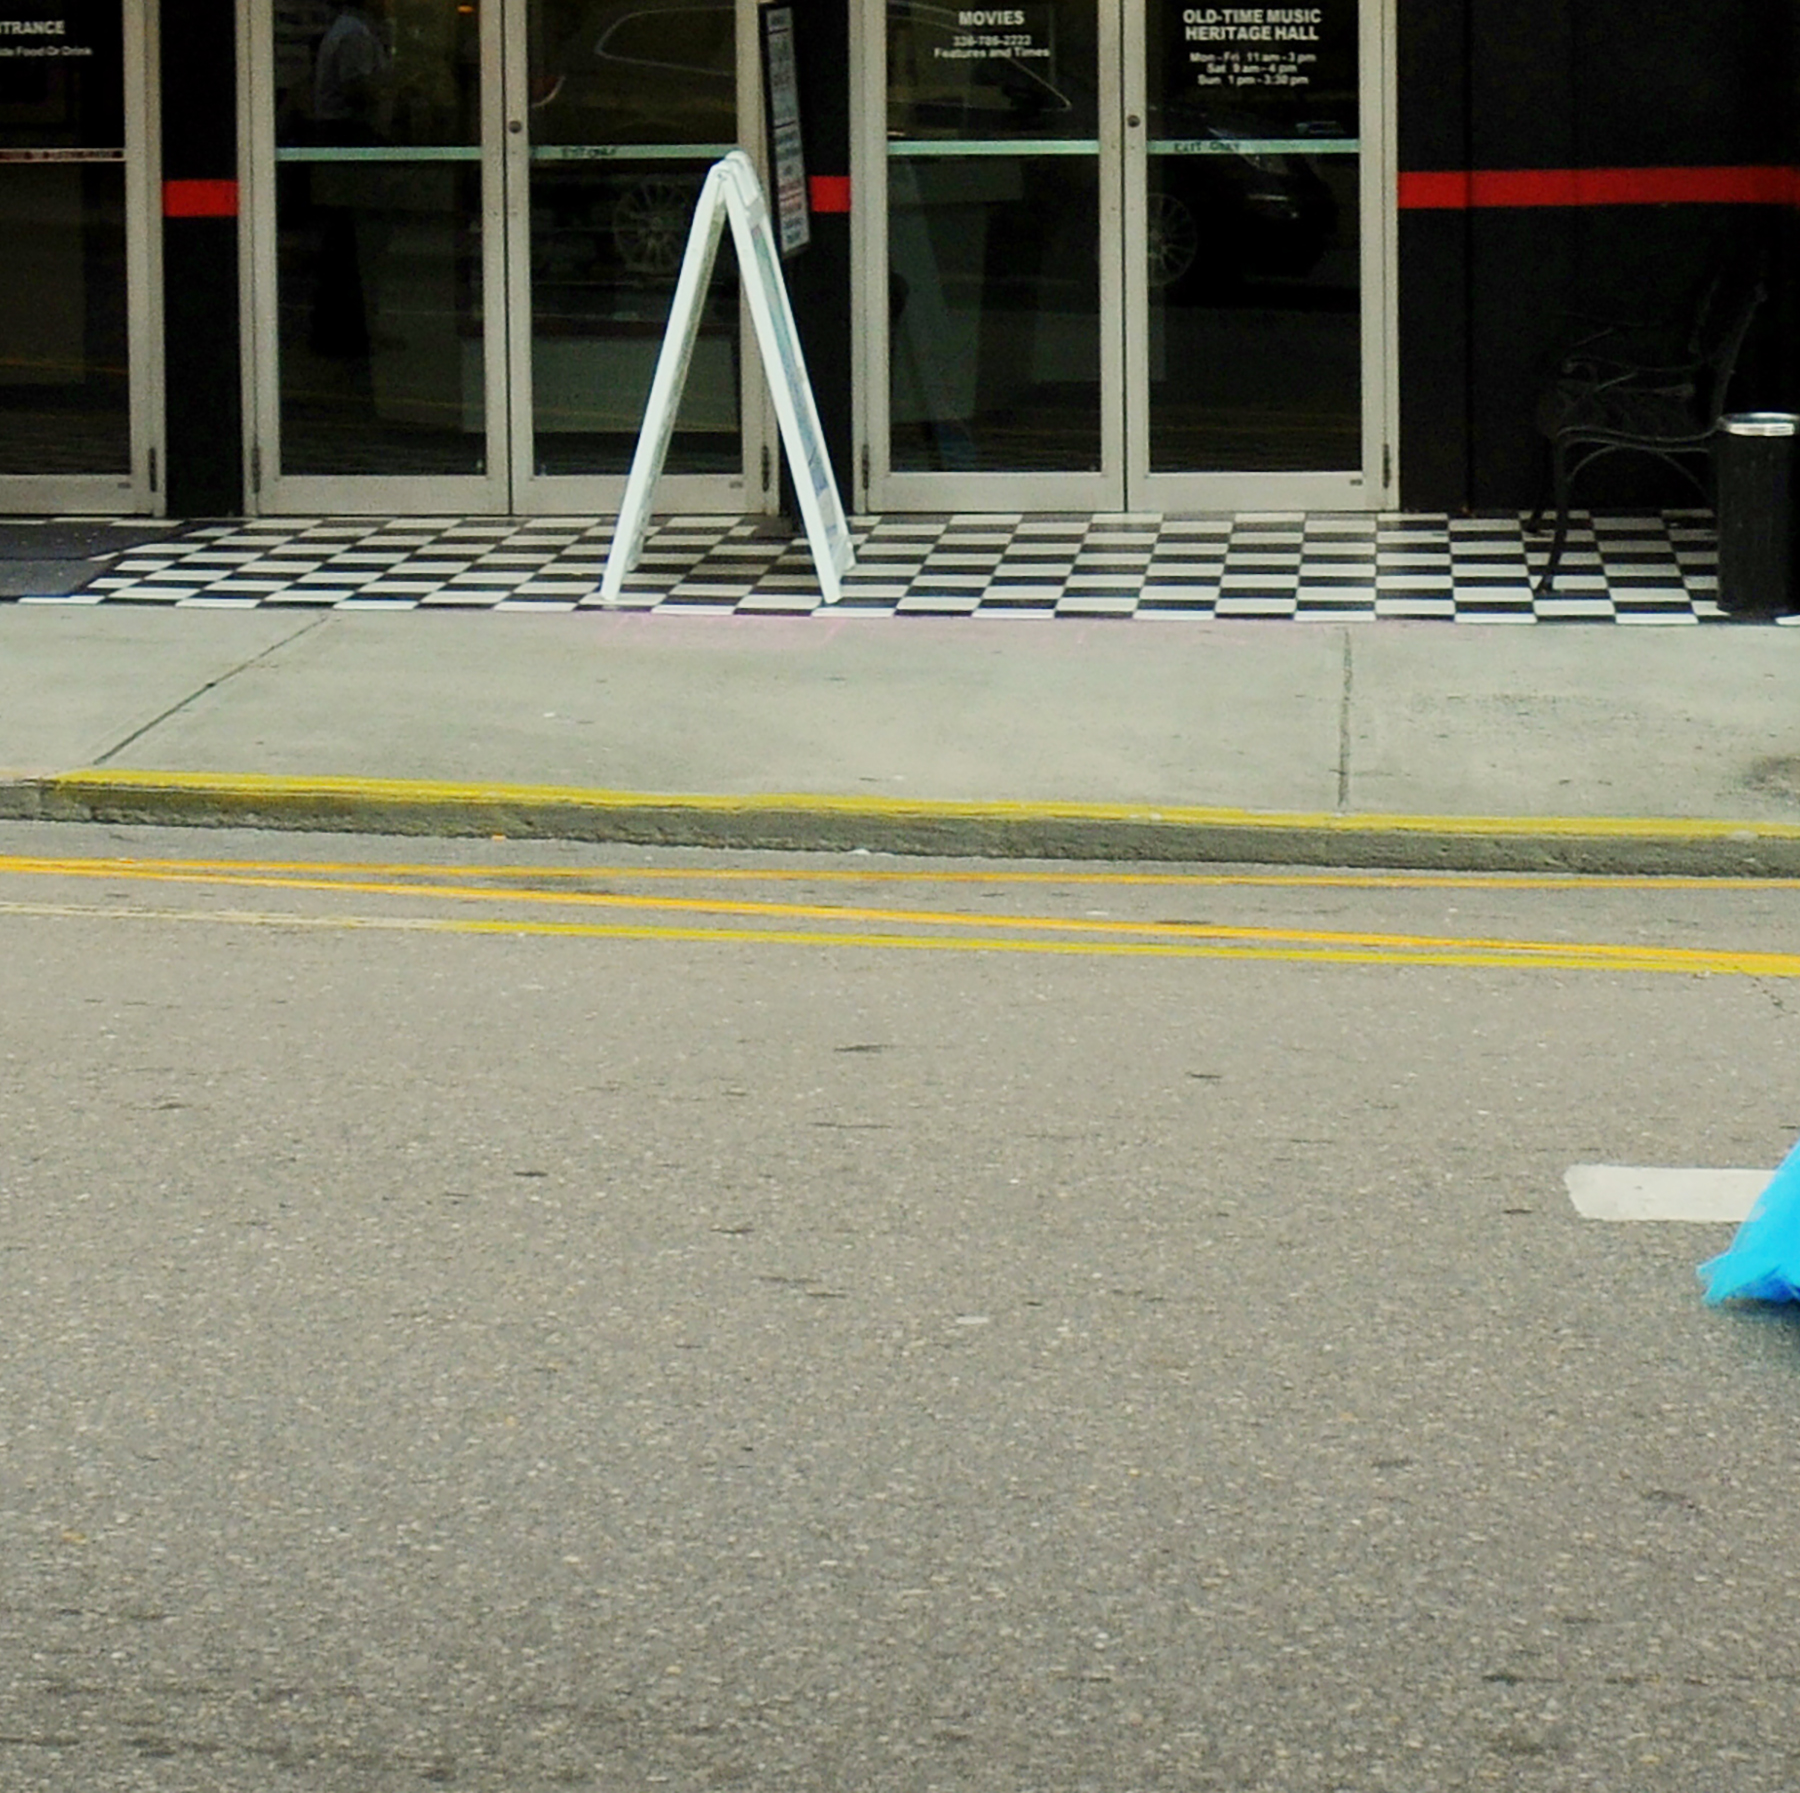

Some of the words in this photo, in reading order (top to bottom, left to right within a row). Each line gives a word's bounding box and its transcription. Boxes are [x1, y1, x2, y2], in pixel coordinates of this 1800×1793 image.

[958, 10, 1026, 26] MOVIES
[1183, 9, 1264, 24] OLD-TIME
[1266, 9, 1322, 23] MUSIC
[1185, 26, 1272, 41] HERITAGE
[1274, 26, 1319, 41] HALL
[16, 46, 45, 57] Food
[934, 46, 987, 58] Features
[988, 47, 1012, 57] and
[1015, 46, 1051, 57] Times
